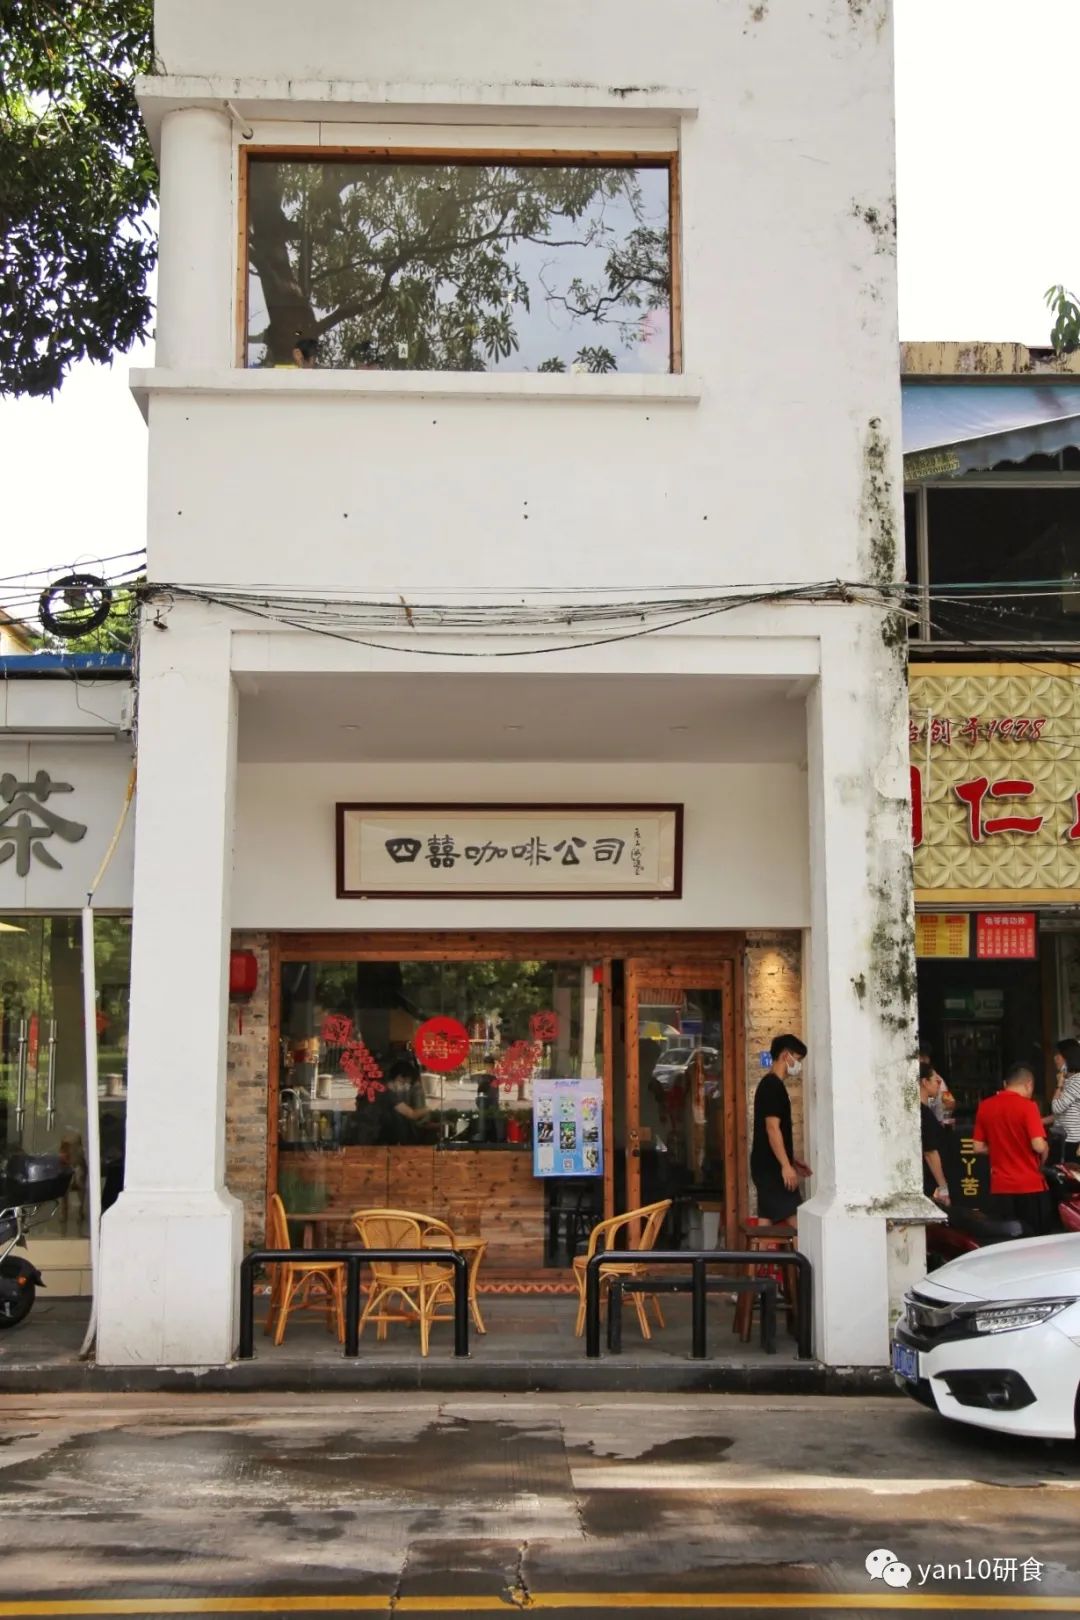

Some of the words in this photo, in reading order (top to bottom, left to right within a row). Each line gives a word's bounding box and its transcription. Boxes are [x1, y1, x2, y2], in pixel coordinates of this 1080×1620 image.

[0, 769, 87, 878] 茶
[385, 833, 626, 869] 四囍咖啡公司
